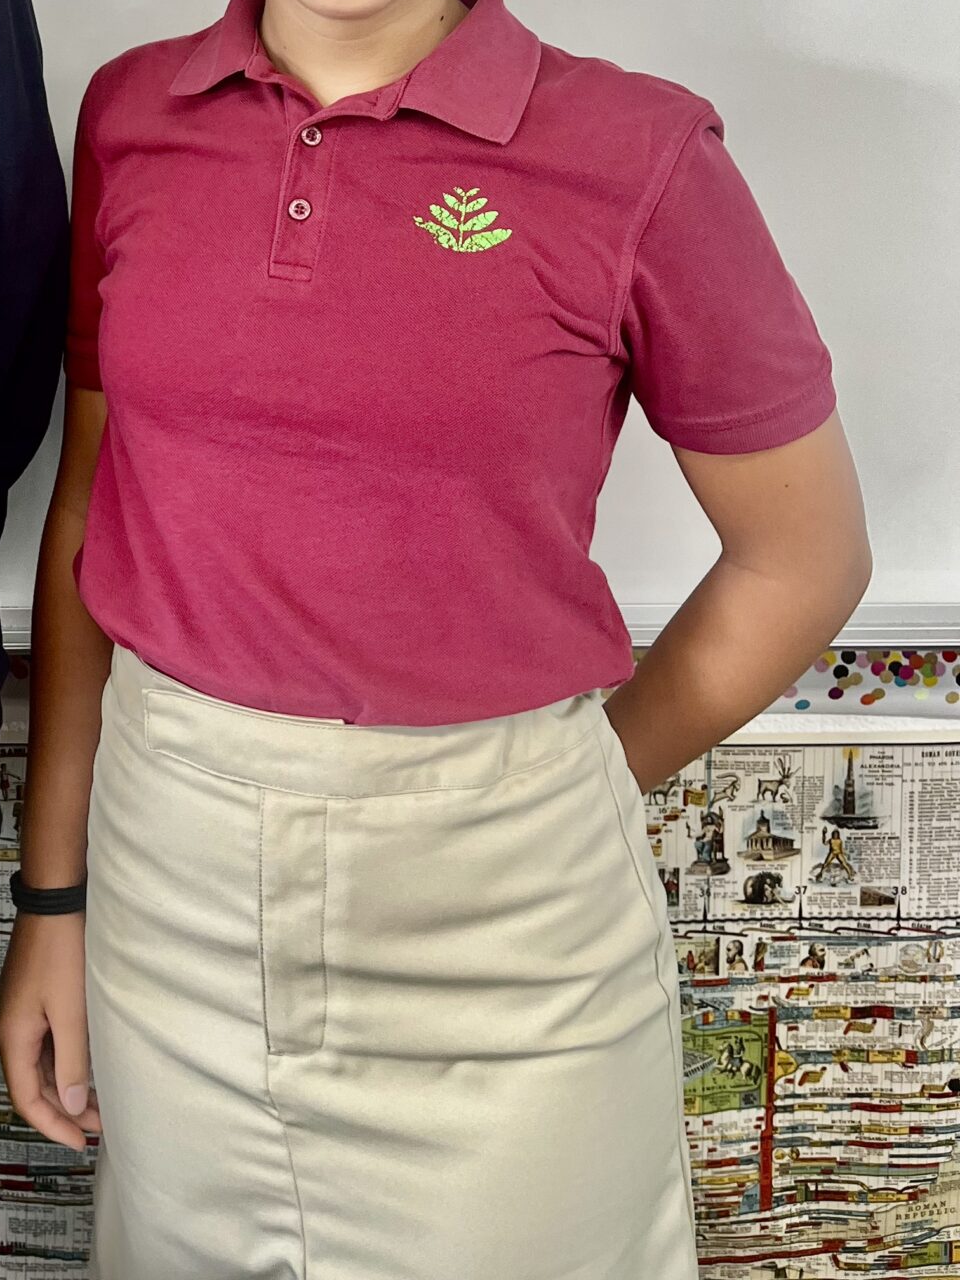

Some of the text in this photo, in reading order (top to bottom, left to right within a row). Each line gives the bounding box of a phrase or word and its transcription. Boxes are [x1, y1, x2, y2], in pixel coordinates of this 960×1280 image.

[794, 885, 808, 895] 37
[891, 886, 908, 896] 38
[907, 1200, 947, 1212] ROMAN
